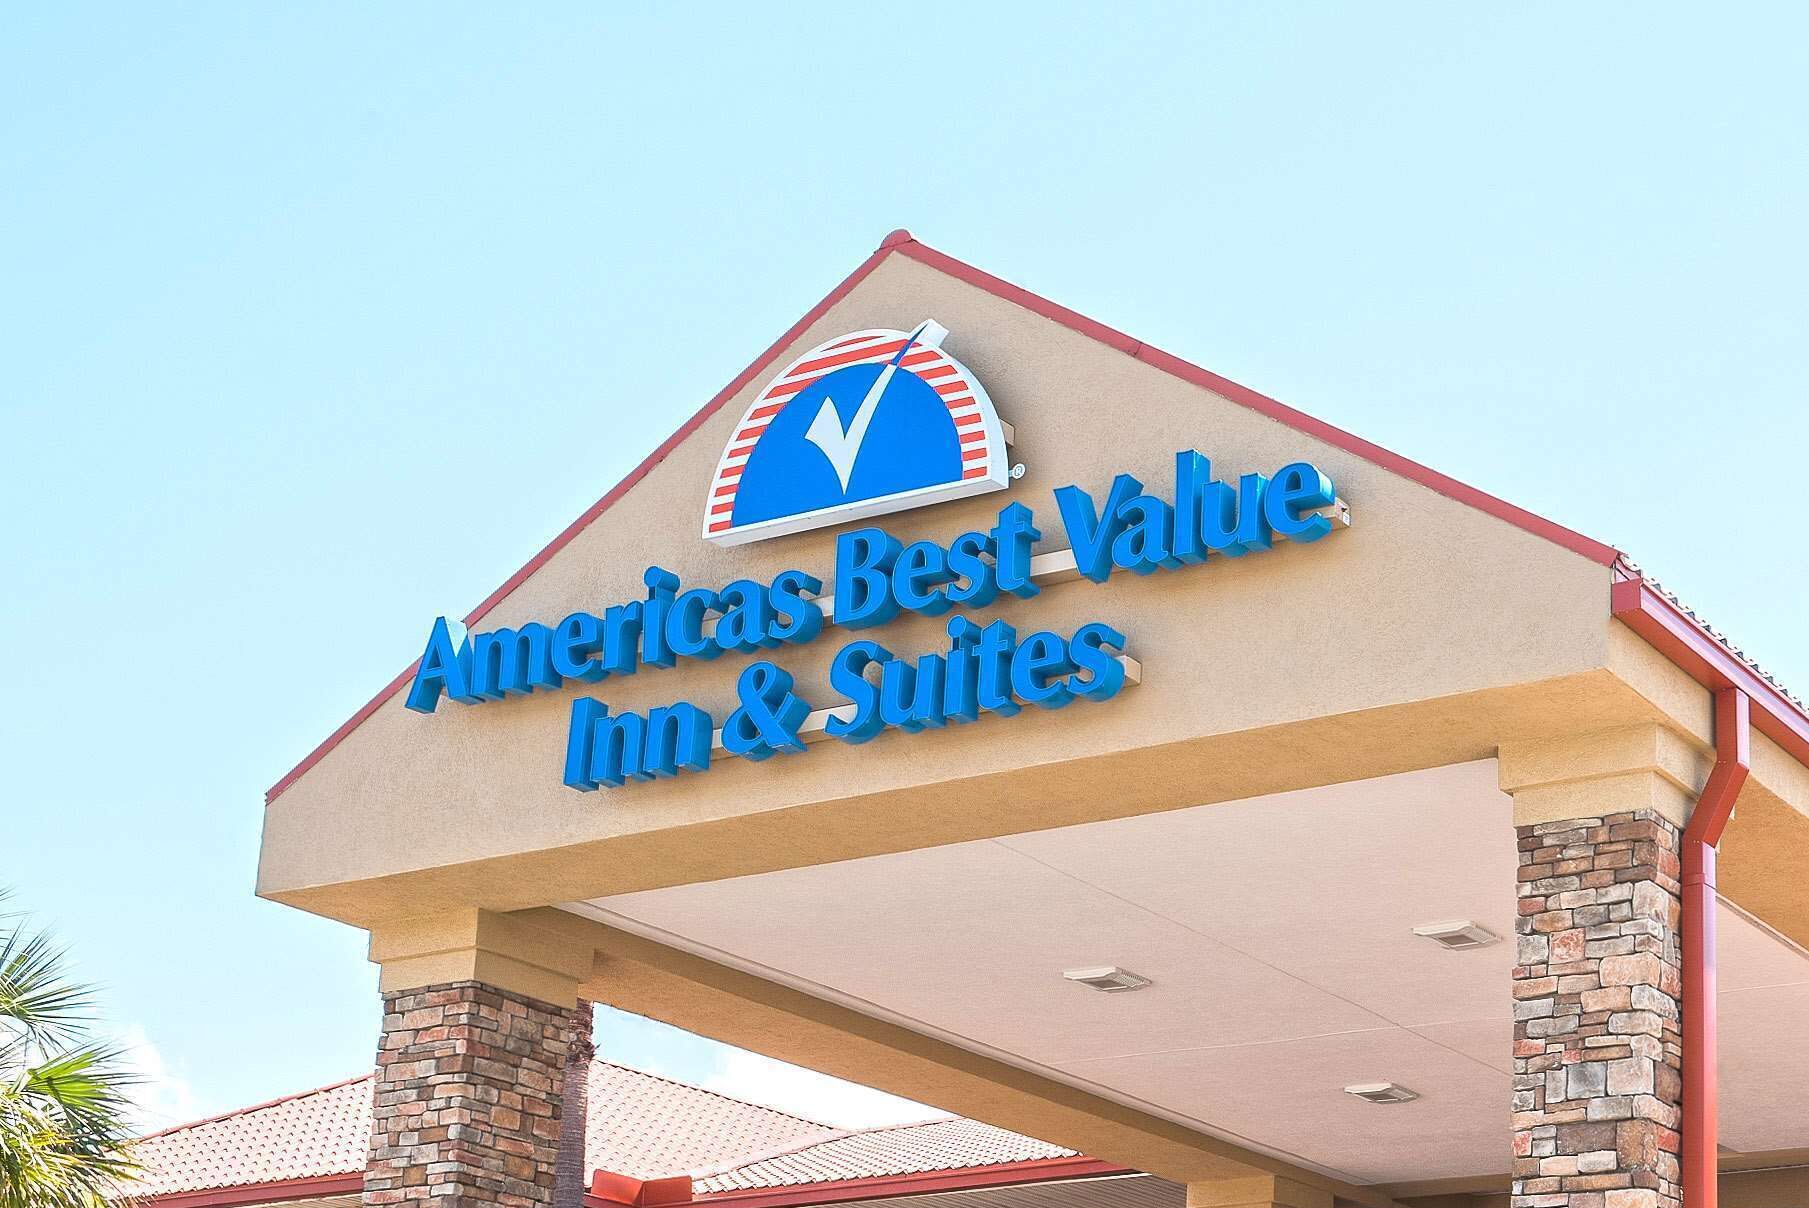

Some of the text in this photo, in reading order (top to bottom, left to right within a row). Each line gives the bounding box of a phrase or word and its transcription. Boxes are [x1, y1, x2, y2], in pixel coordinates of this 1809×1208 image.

[404, 448, 1337, 714] Americas Best Value
[563, 614, 1127, 793] Inn & Suites
